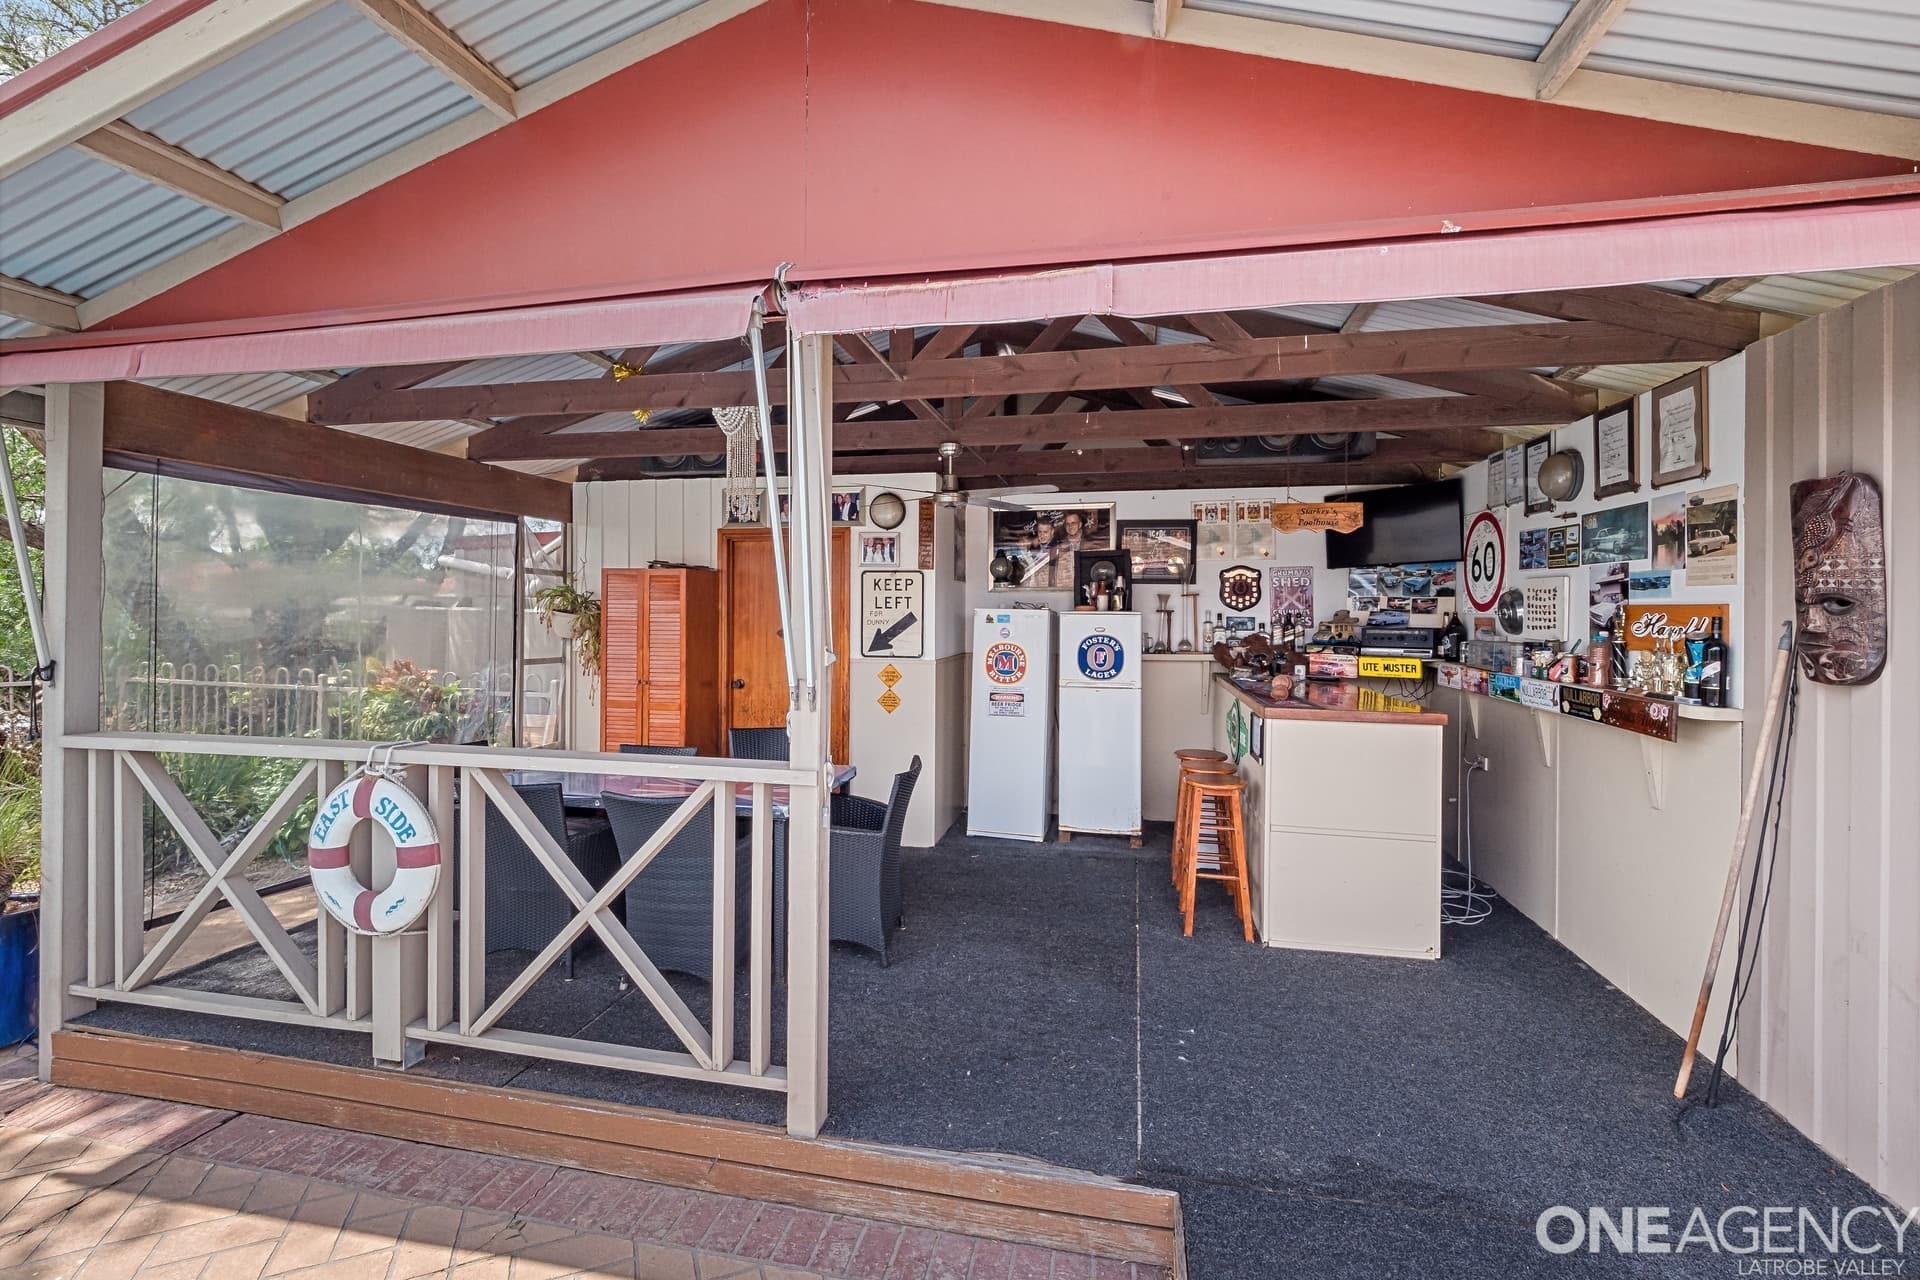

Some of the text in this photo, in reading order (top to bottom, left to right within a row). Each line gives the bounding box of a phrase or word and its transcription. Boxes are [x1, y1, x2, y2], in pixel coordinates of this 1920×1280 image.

[1471, 541, 1496, 582] 60
[873, 578, 914, 591] KEEP
[1272, 577, 1310, 588] SHED
[875, 596, 912, 609] LEFT
[987, 644, 1025, 667] MELBOURNE
[1085, 668, 1117, 678] LAGER
[1362, 662, 1417, 673] UTE MUSTER
[988, 670, 1023, 683] BITTER
[313, 789, 417, 844] EAST SIDE
